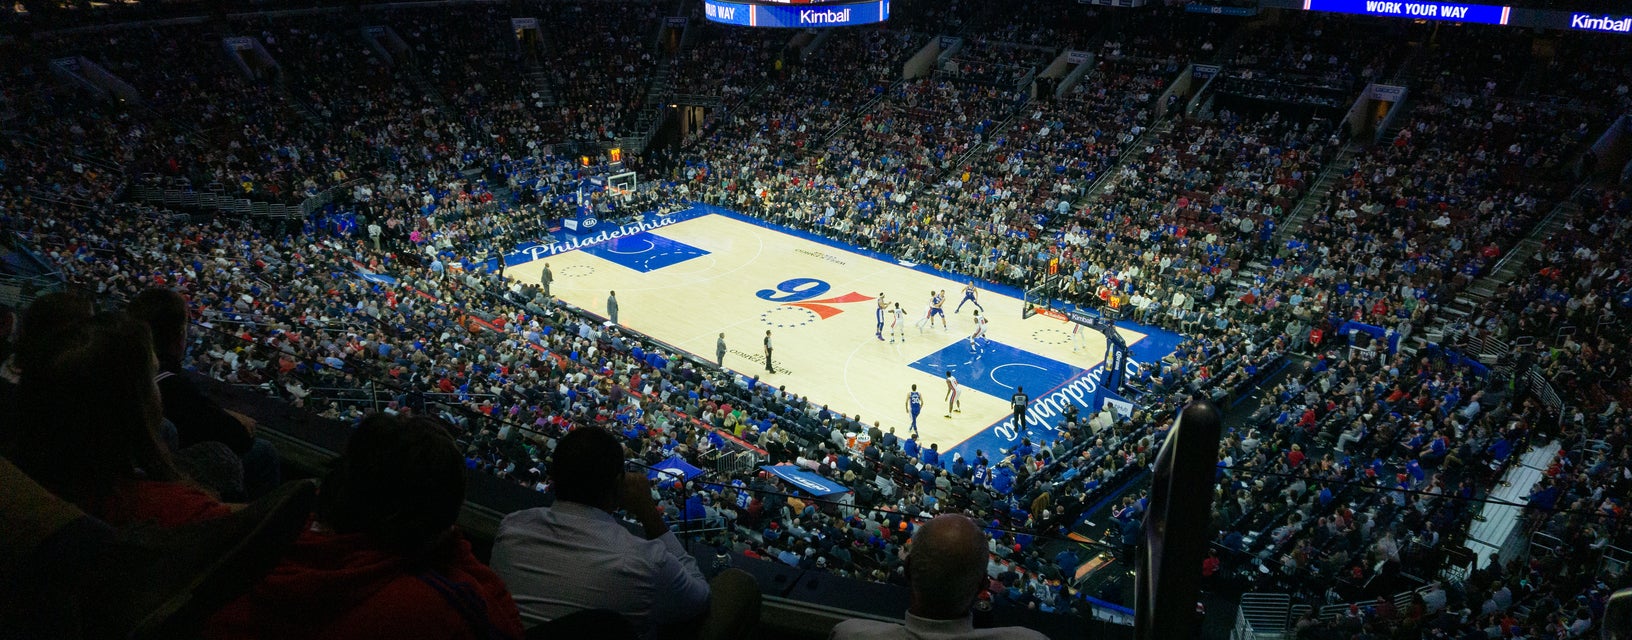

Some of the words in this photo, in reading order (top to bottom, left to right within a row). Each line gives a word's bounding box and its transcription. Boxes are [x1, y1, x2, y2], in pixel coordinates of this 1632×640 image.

[717, 5, 735, 20] WAY
[800, 8, 850, 24] Kimball
[1366, 0, 1401, 14] WORK
[1405, 3, 1437, 17] YOUR
[1440, 6, 1469, 19] WAY
[1571, 14, 1632, 32] Kimball
[521, 215, 677, 261] Philadelphia
[976, 471, 984, 479] 21
